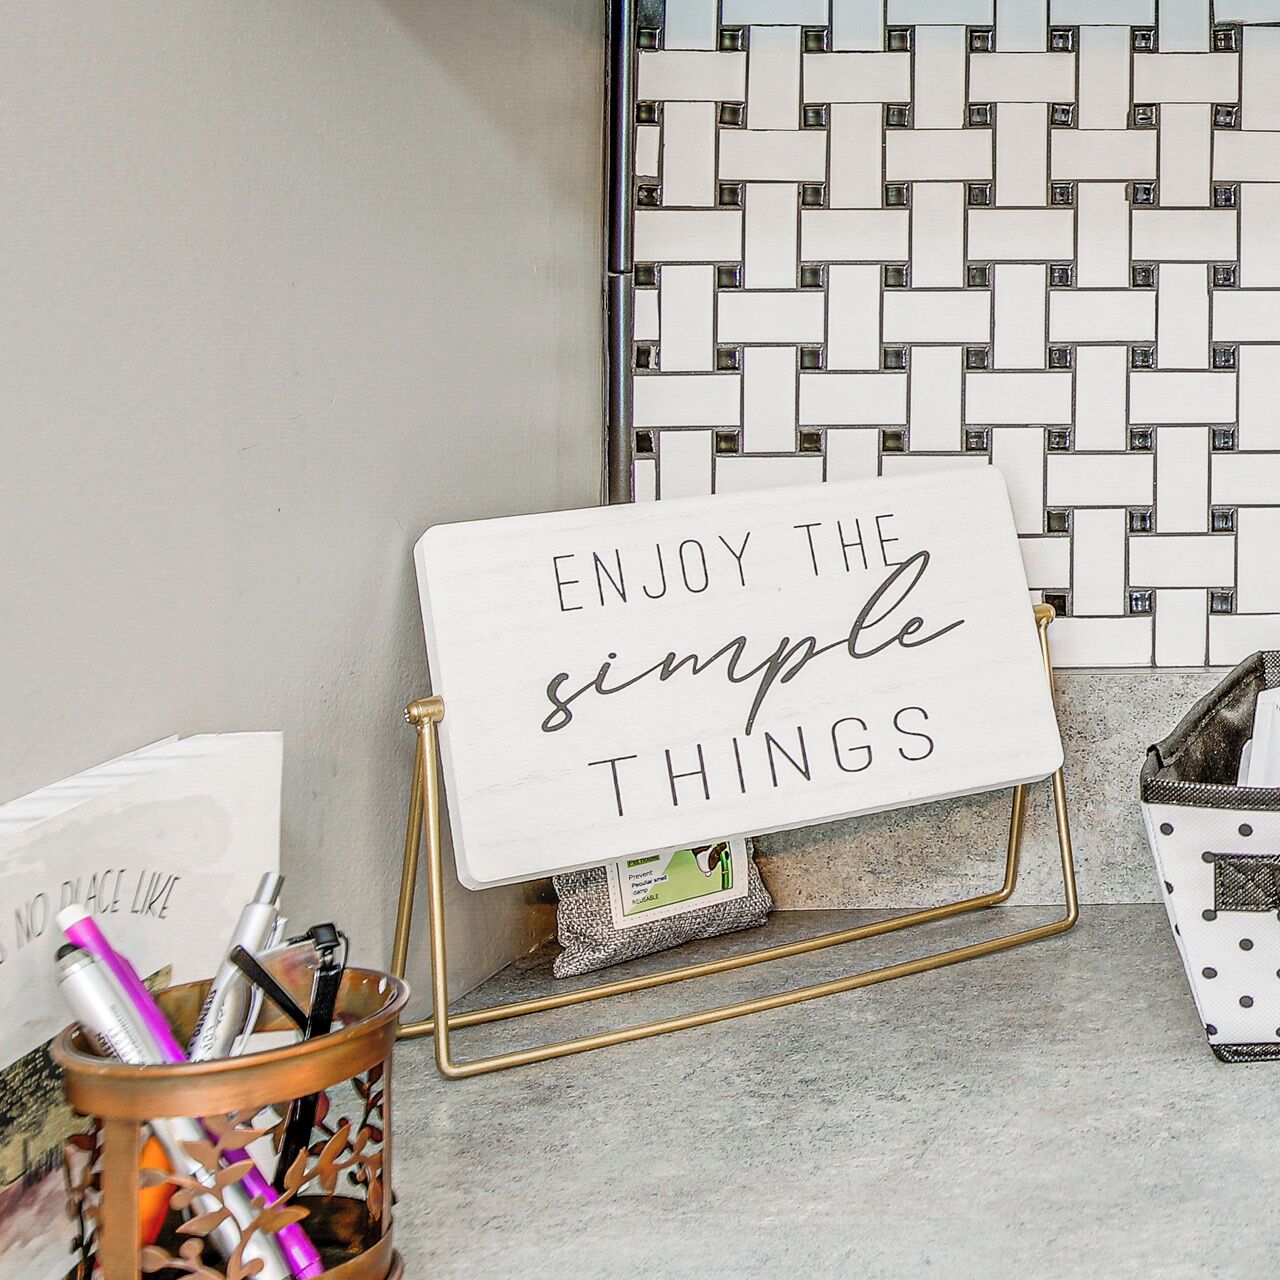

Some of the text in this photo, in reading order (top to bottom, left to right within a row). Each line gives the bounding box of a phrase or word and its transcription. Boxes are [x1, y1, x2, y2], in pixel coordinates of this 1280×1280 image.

[551, 512, 904, 613] ENJOY THE
[540, 549, 966, 736] simple
[587, 705, 937, 818] THINGS
[628, 870, 653, 881] Prevent
[631, 874, 667, 888] Peculiar smell
[631, 892, 659, 905] REUSABLE
[632, 887, 649, 896] damp
[13, 892, 50, 950] NO
[130, 868, 183, 920] LIKE
